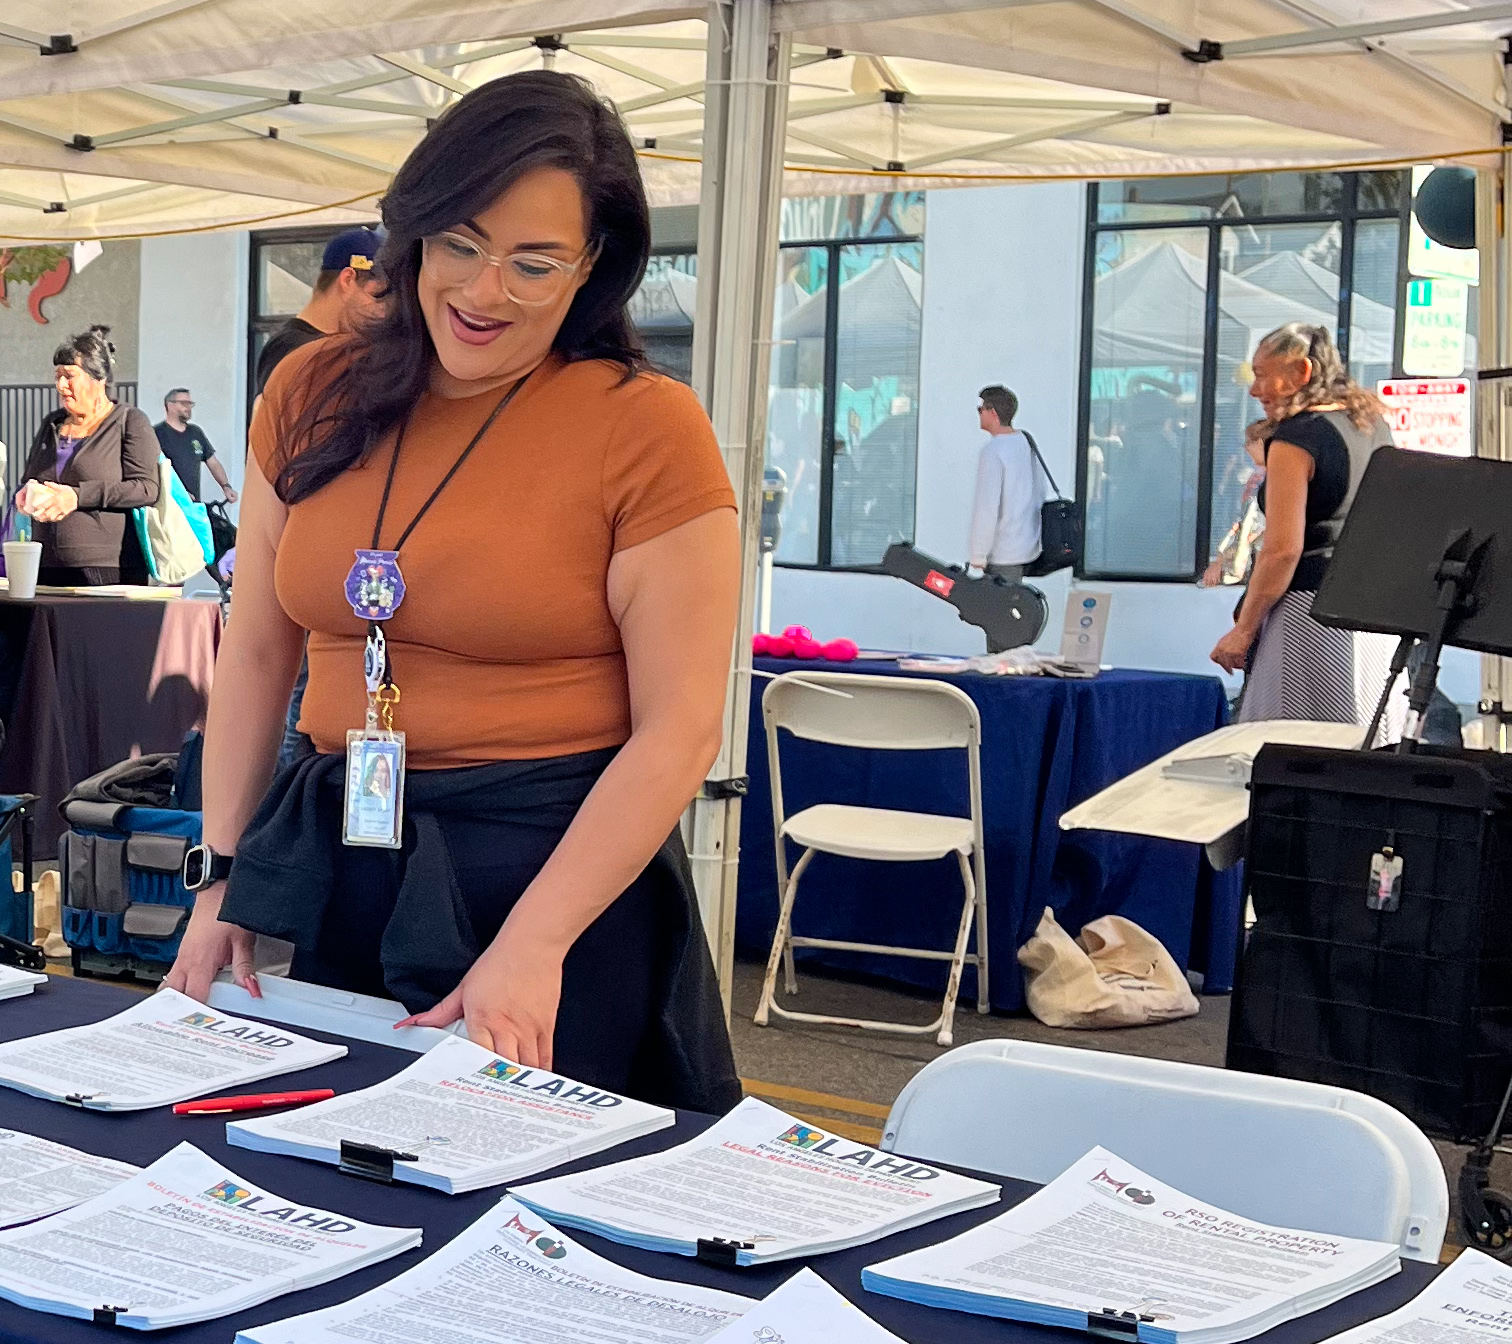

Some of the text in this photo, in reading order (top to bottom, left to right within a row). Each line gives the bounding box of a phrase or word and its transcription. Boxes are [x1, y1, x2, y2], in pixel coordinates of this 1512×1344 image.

[1411, 312, 1462, 329] PARKING
[203, 1020, 294, 1048] LAHD
[438, 1080, 515, 1103] RELOCATION
[510, 1070, 623, 1107] LAHD
[722, 1141, 933, 1198] LEGAL REASONS FOR EVICTION
[757, 1143, 785, 1154] Rent
[787, 1153, 864, 1175] Stabilization
[812, 1138, 940, 1181] LAHD
[164, 1202, 208, 1219] PAGOS
[209, 1216, 234, 1227] DEL
[291, 1237, 317, 1248] DEL
[237, 1196, 357, 1233] LAHD
[1162, 1210, 1345, 1256] OF RENTAL PROPERTY
[1186, 1208, 1340, 1249] RSO REGISTRATION
[488, 1243, 554, 1281] RAZONES
[556, 1276, 620, 1299] LEGALES
[623, 1293, 645, 1304] DE
[646, 1298, 727, 1321] DESALOJO
